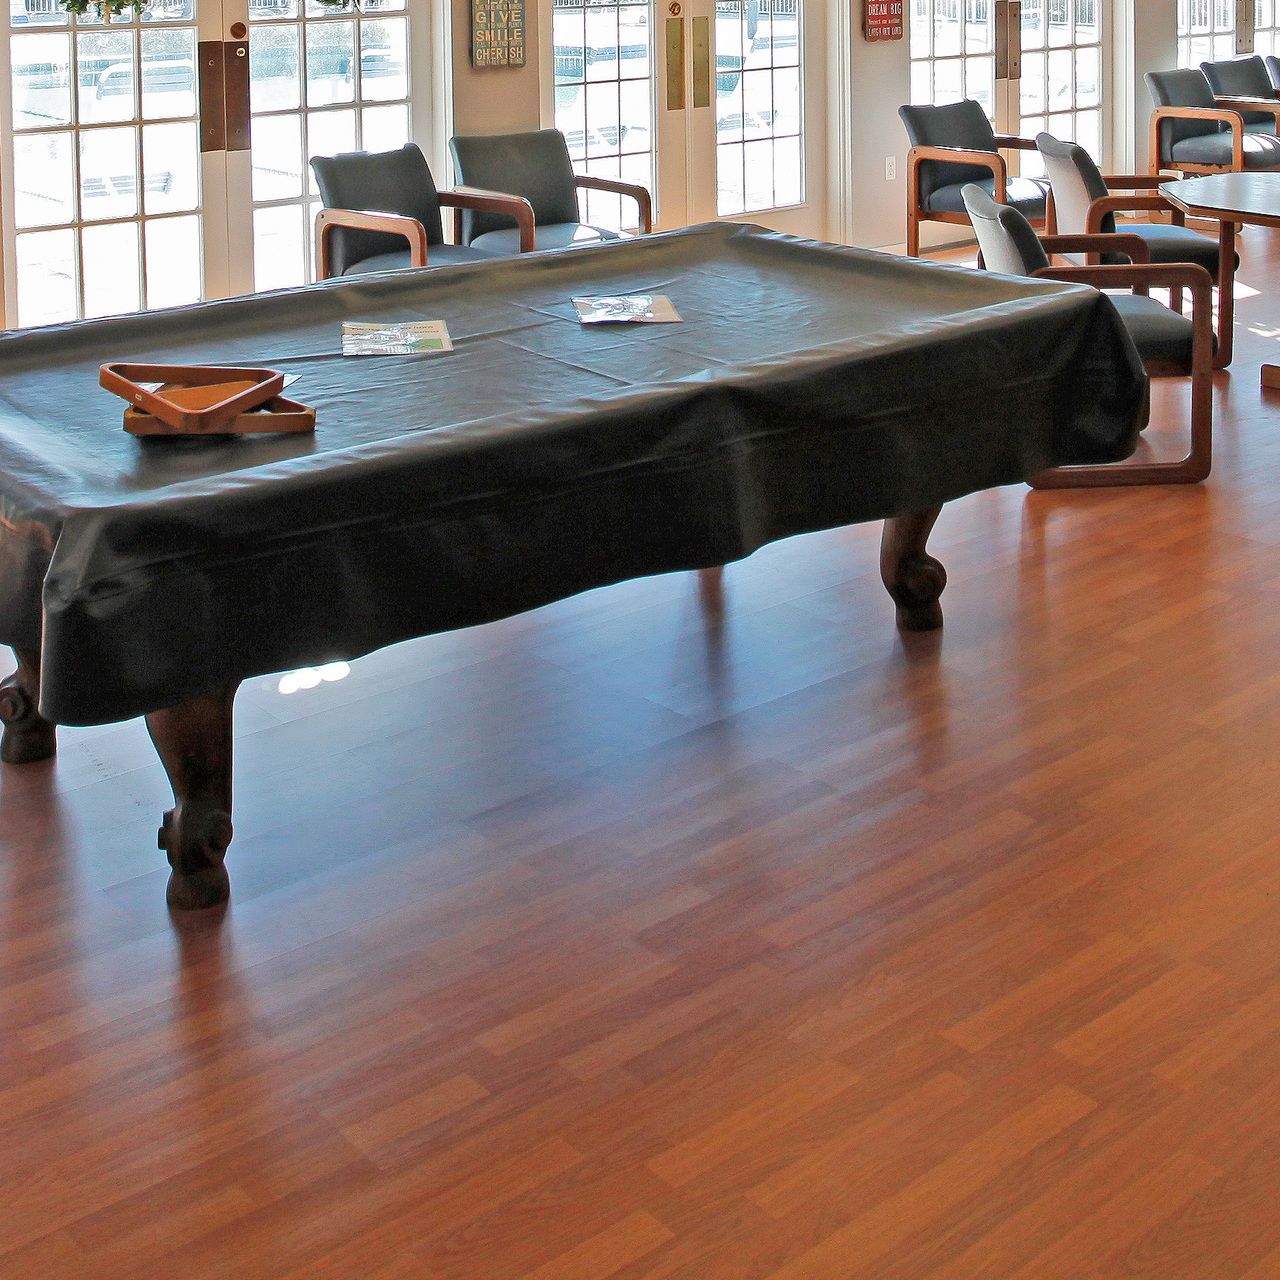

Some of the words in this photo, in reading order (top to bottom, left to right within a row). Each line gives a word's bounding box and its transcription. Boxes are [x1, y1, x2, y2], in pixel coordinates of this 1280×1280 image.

[868, 3, 888, 16] DREAM
[890, 2, 902, 15] BIG
[476, 10, 522, 24] GIVE
[476, 28, 523, 42] SMILE
[476, 46, 523, 60] CHERISH
